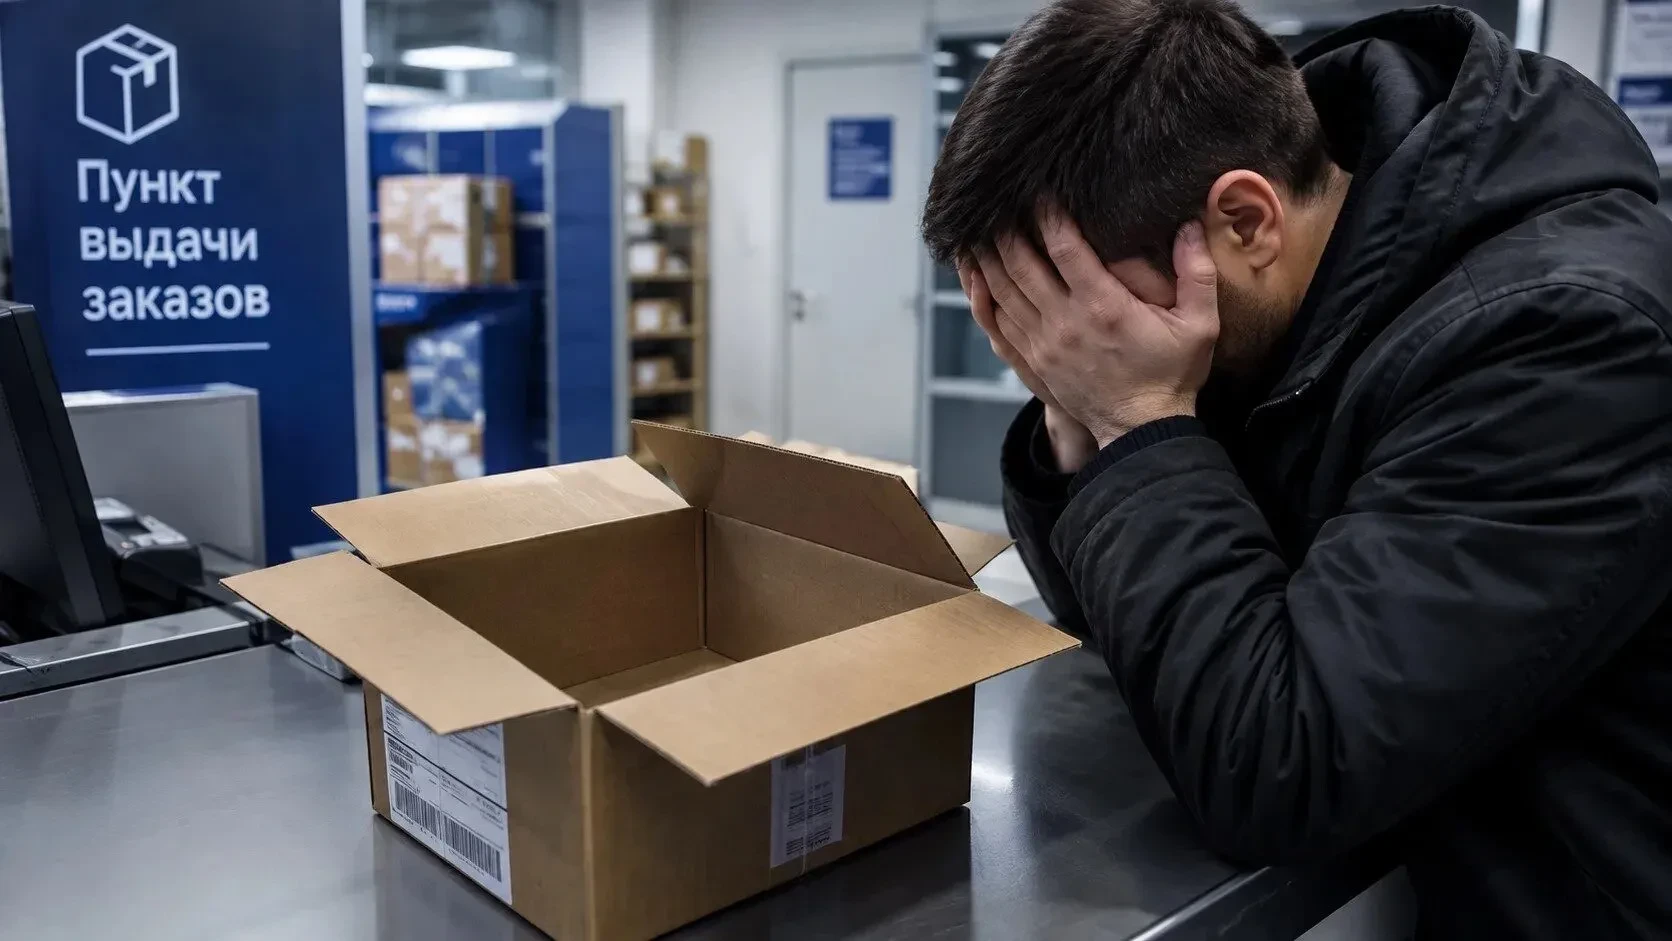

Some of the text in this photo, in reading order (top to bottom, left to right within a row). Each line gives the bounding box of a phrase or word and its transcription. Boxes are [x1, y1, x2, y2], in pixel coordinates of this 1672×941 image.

[77, 158, 222, 213] Пункт
[79, 226, 259, 269] выдачи
[82, 284, 271, 321] заказов
